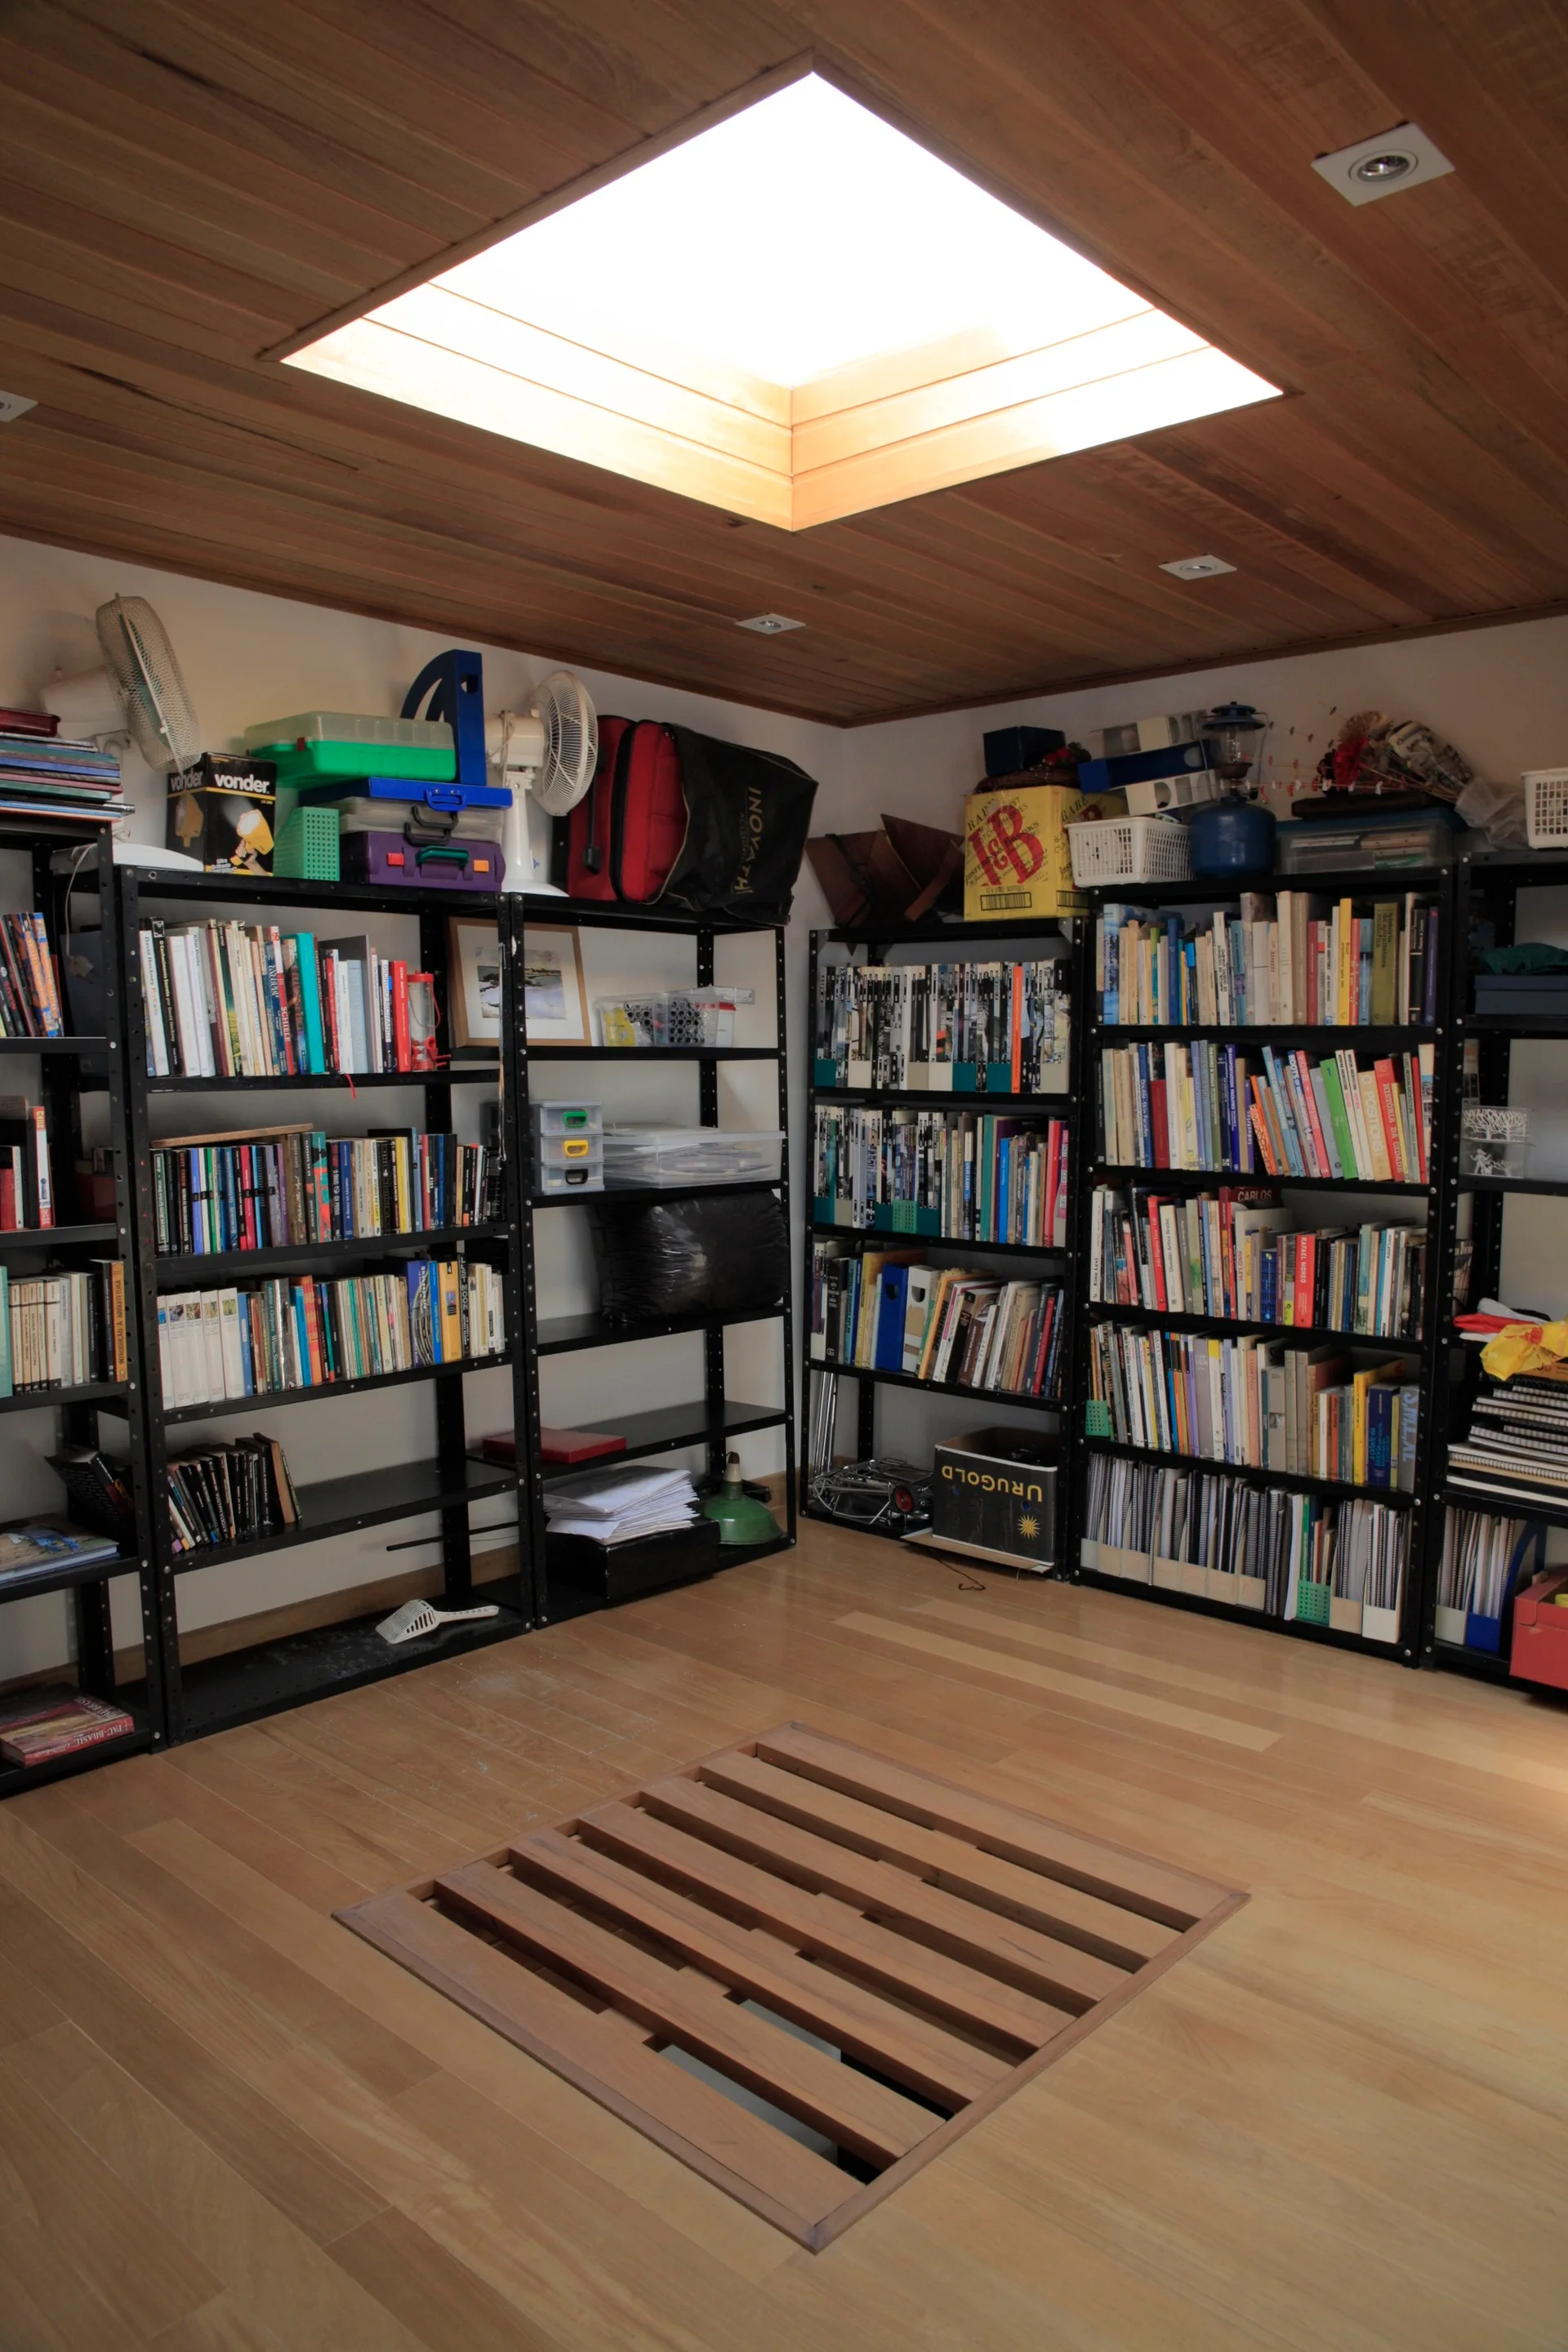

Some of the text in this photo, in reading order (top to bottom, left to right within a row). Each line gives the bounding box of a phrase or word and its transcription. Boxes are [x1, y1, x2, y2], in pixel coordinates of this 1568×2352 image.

[170, 768, 203, 791] vonder
[214, 773, 270, 794] vonder
[1061, 796, 1089, 821] RARE
[968, 805, 1044, 887] J&B
[1382, 913, 1388, 922] da
[145, 937, 153, 956] David
[147, 956, 155, 986] Hockney
[160, 945, 169, 978] Conhecimento
[1105, 973, 1113, 991] today
[281, 1007, 291, 1043] SCHIELE
[1288, 1054, 1298, 1079] ROOTS
[1367, 1091, 1383, 1153] POSITIONS
[1383, 1083, 1403, 1174] HISTÓRIA DA CIDADE
[1236, 1192, 1272, 1201] CARLOS
[933, 1300, 948, 1352] HOUSING
[942, 1465, 1043, 1503] URUGOLD
[73, 1724, 123, 1746] PAU-BRASIL
